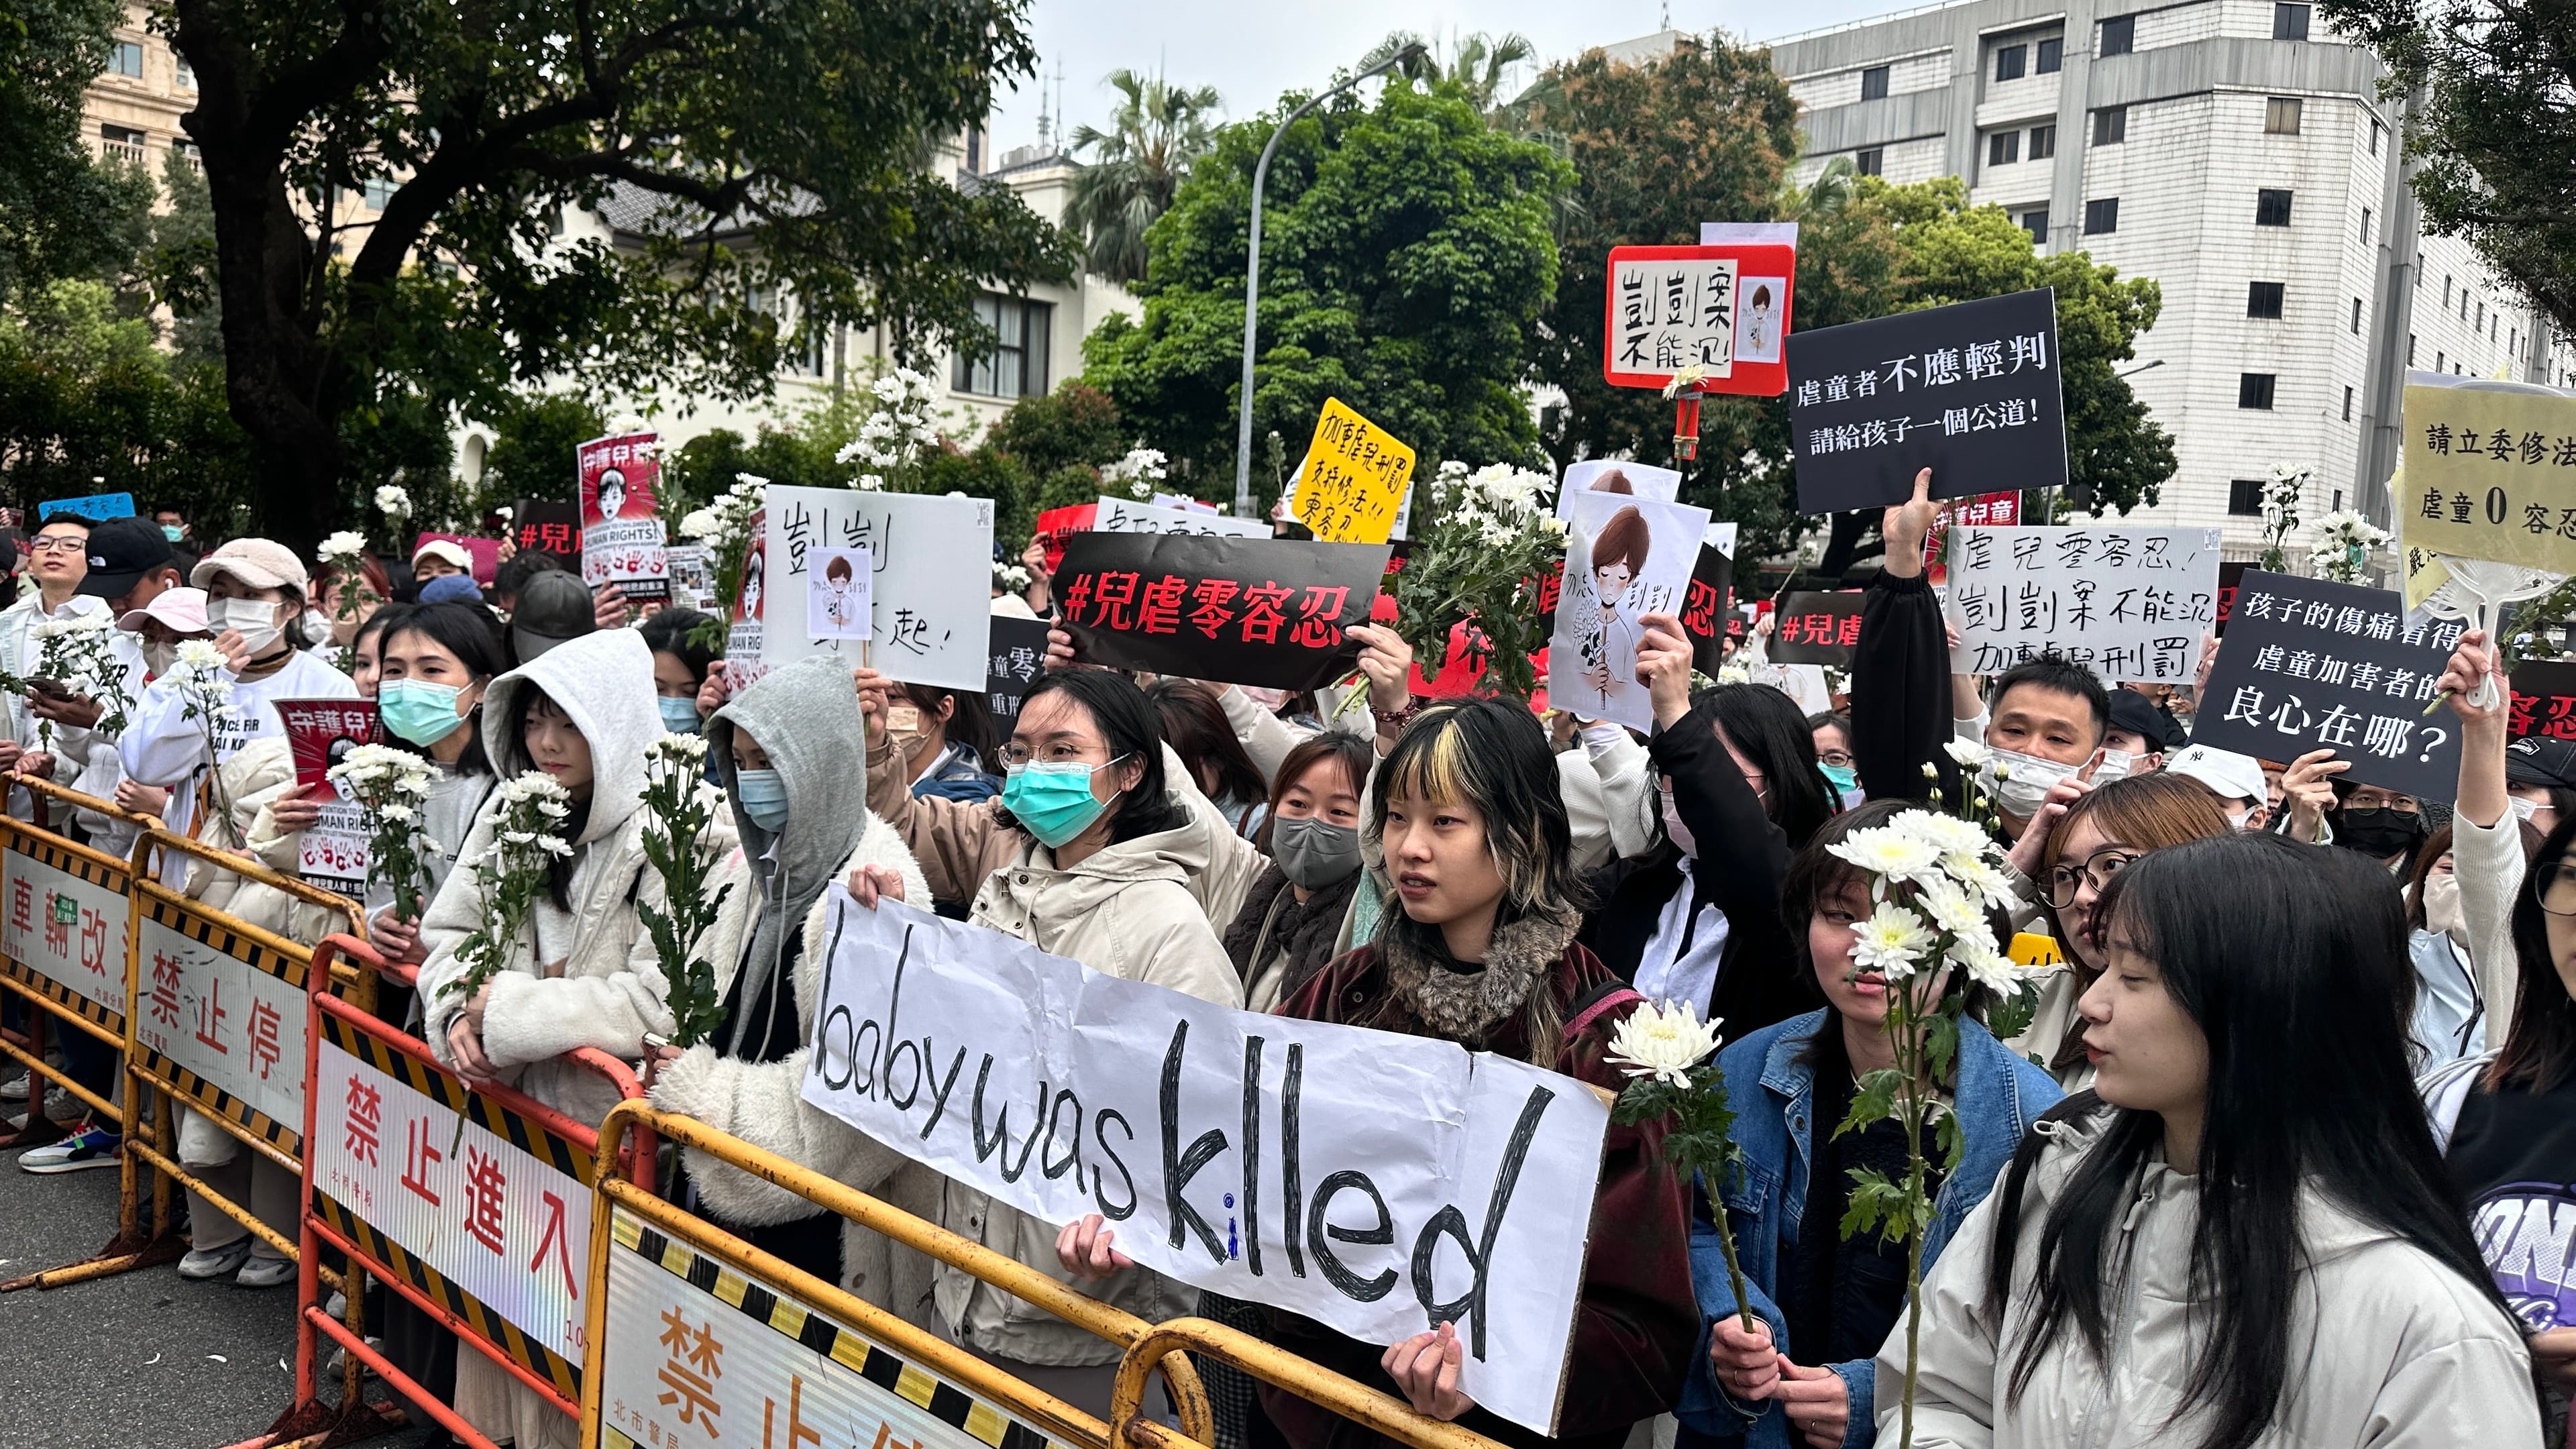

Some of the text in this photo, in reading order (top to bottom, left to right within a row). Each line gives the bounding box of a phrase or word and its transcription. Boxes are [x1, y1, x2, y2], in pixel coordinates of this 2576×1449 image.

[1623, 266, 1731, 331] 剴剴案
[1796, 331, 2047, 408] 虐童者不應輕判
[1321, 410, 1407, 494] 加重虐兒刑罰
[1809, 398, 2039, 455] 請給孩子一個公道!
[2425, 423, 2576, 467] 請立委修法
[519, 523, 582, 554] #兒
[609, 527, 658, 541] RIGHTS!
[1064, 570, 1350, 649] #兒虐零容忍
[1782, 613, 1863, 646] #兒虐
[2244, 591, 2463, 652] 孩子的傷痛看得
[987, 647, 1049, 684] 童零
[2253, 644, 2443, 702] 虐童加害者的
[2224, 685, 2447, 763] 良心在哪?
[315, 814, 377, 832] UMAN RIGH
[151, 948, 307, 1089] 禁止停
[814, 899, 1555, 1363] baby was killed
[345, 1073, 578, 1300] 禁止進入
[614, 1397, 680, 1449] 北市警局
